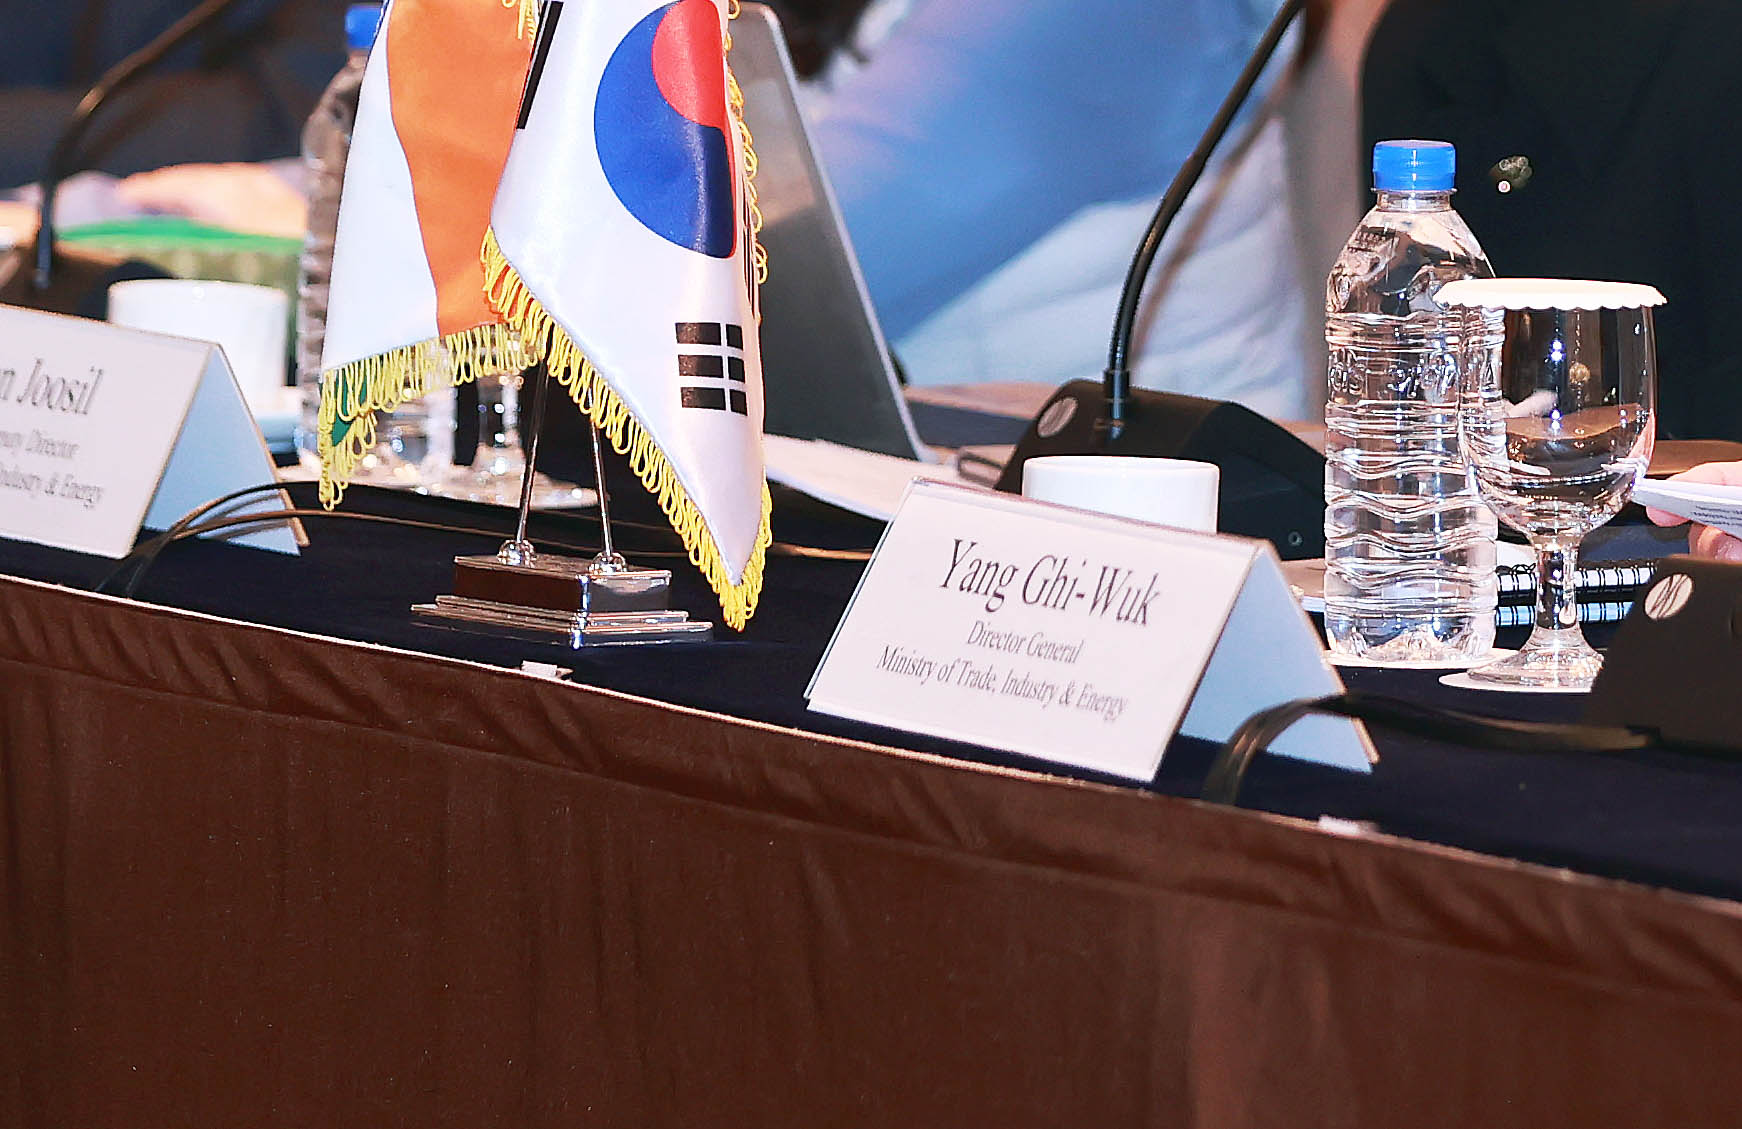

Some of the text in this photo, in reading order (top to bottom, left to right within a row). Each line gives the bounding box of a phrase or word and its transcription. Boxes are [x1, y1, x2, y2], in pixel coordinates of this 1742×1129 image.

[939, 538, 1160, 625] Yang Ghi-Wuk
[967, 620, 1084, 664] Director General
[876, 644, 1128, 721] Ministry of Trade, Industry & Energy
